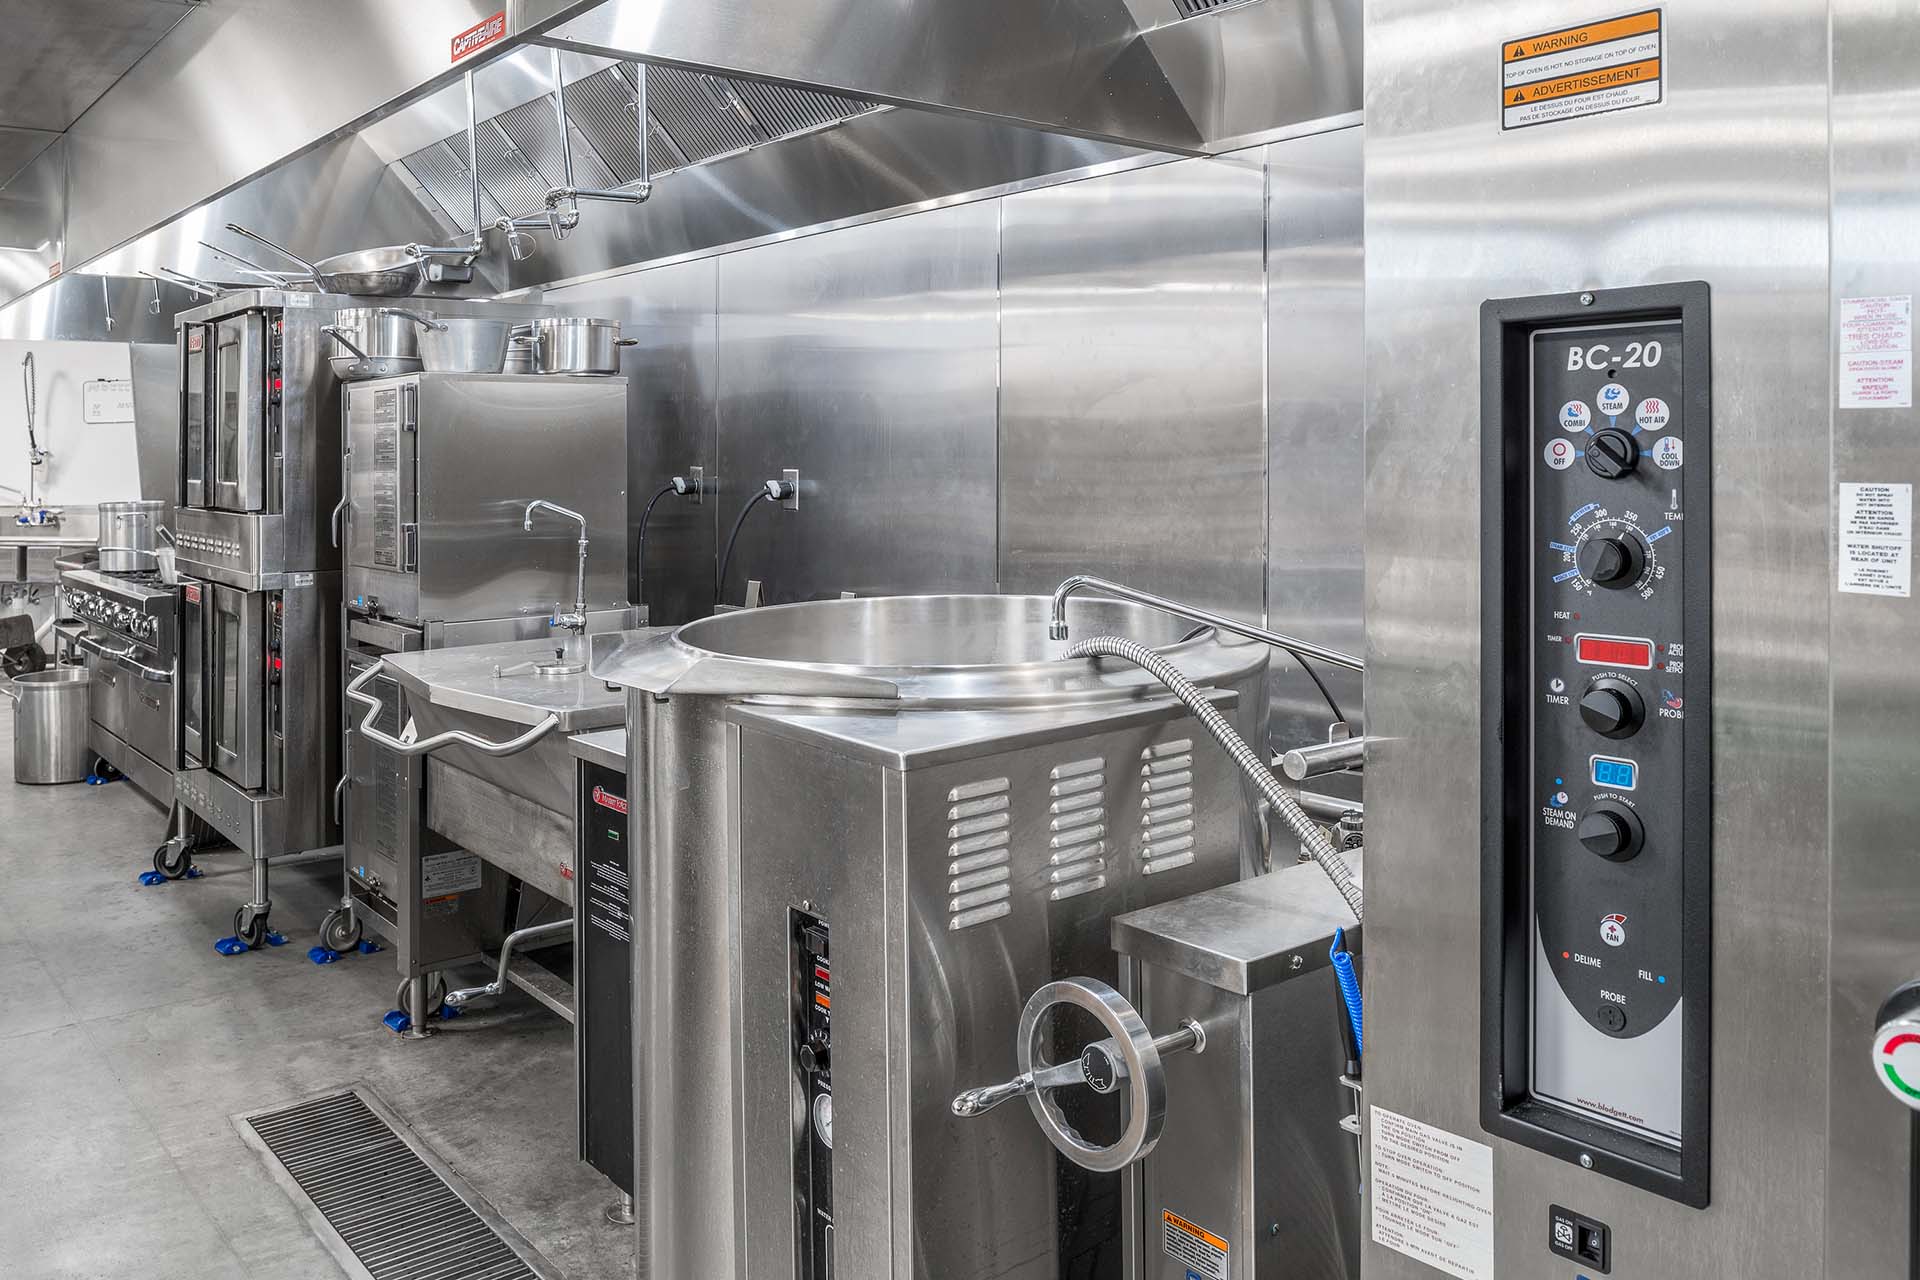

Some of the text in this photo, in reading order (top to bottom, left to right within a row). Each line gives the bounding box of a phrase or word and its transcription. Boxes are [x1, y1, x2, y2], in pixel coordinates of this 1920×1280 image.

[1532, 31, 1588, 53] WARNING
[1506, 70, 1516, 79] TOP
[1517, 68, 1524, 77] OF
[1526, 65, 1543, 75] OVEN
[1544, 63, 1549, 71] IS
[1564, 59, 1573, 67] NO
[1574, 53, 1603, 66] STORAGE
[1604, 51, 1613, 60] ON
[1614, 48, 1627, 58] TOP
[1628, 46, 1636, 55] OF
[1638, 42, 1655, 53] OVEN
[1532, 66, 1640, 98] ADVERTISSEMENT
[1530, 88, 1628, 113] LE DESSUS DU FOUR EST CHAUD
[1519, 113, 1531, 122] PAS
[1531, 112, 1539, 120] DE
[1540, 106, 1573, 118] STOCKAGE
[1574, 104, 1584, 113] ON
[1585, 100, 1611, 111] DESSUS
[1612, 98, 1621, 106] DU
[1567, 341, 1662, 371] BC-20
[1602, 402, 1623, 410] STEAM
[1564, 419, 1586, 427] COMBI
[1639, 416, 1665, 424] HOT AIR
[1553, 458, 1566, 466] OFF
[1594, 508, 1608, 519] 300
[1624, 510, 1638, 522] 350
[1664, 512, 1684, 521] TEM
[1570, 523, 1583, 536] 250
[1655, 566, 1666, 580] 450
[1570, 578, 1583, 592] 150
[1640, 587, 1654, 600] 500
[1553, 611, 1570, 619] HEAT
[1668, 649, 1683, 657] ACTU
[1665, 666, 1683, 674] SETPO
[1592, 672, 1608, 681] PUSH
[1618, 673, 1638, 687] SELECT
[1545, 694, 1569, 705] TIMER
[1659, 708, 1684, 719] PROB
[1593, 793, 1609, 801] PUSH
[1618, 795, 1636, 808] START
[1542, 807, 1577, 821] STEAM ON
[1545, 816, 1574, 829] DEMAND
[818, 920, 830, 928] POW
[1606, 932, 1619, 942] FAN
[816, 955, 830, 965] COOK
[1574, 953, 1602, 968] DELIME
[1638, 969, 1653, 982] FILL
[814, 980, 824, 990] LOW
[1600, 989, 1626, 1005] PROBE
[814, 1004, 826, 1014] COOK
[1577, 1096, 1644, 1124] www.blodgett.com
[1173, 1216, 1205, 1239] WARNING
